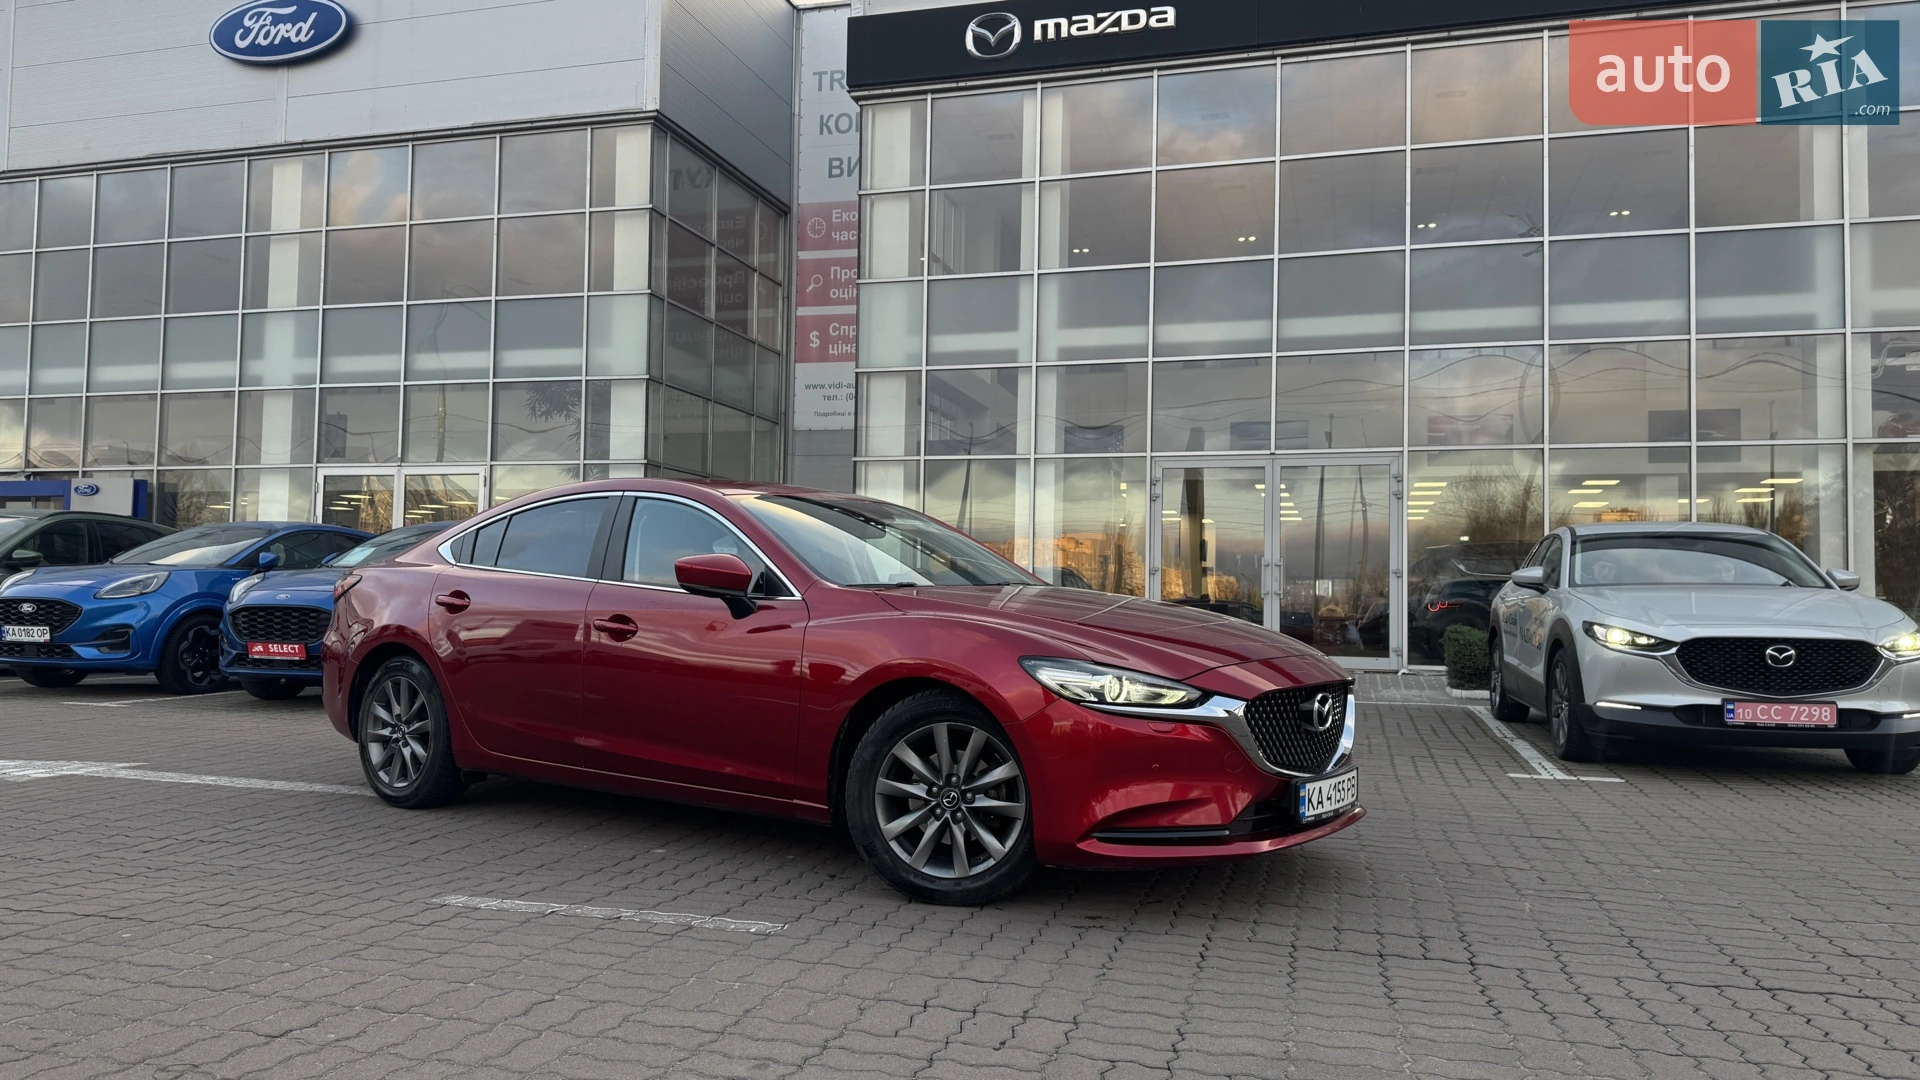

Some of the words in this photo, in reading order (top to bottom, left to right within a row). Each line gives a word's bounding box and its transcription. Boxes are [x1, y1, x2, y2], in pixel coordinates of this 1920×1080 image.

[234, 5, 318, 49] Ford
[812, 69, 847, 92] TR
[845, 392, 856, 402] (0
[6, 628, 17, 638] KA
[18, 628, 35, 638] 0182
[36, 629, 48, 639] OP
[268, 644, 300, 653] SELECT
[1737, 708, 1752, 720] 10
[1756, 704, 1783, 720] CC
[1788, 706, 1831, 722] 7298
[1307, 786, 1324, 812] KA
[1326, 779, 1346, 807] 4155
[1346, 775, 1356, 801] PB
